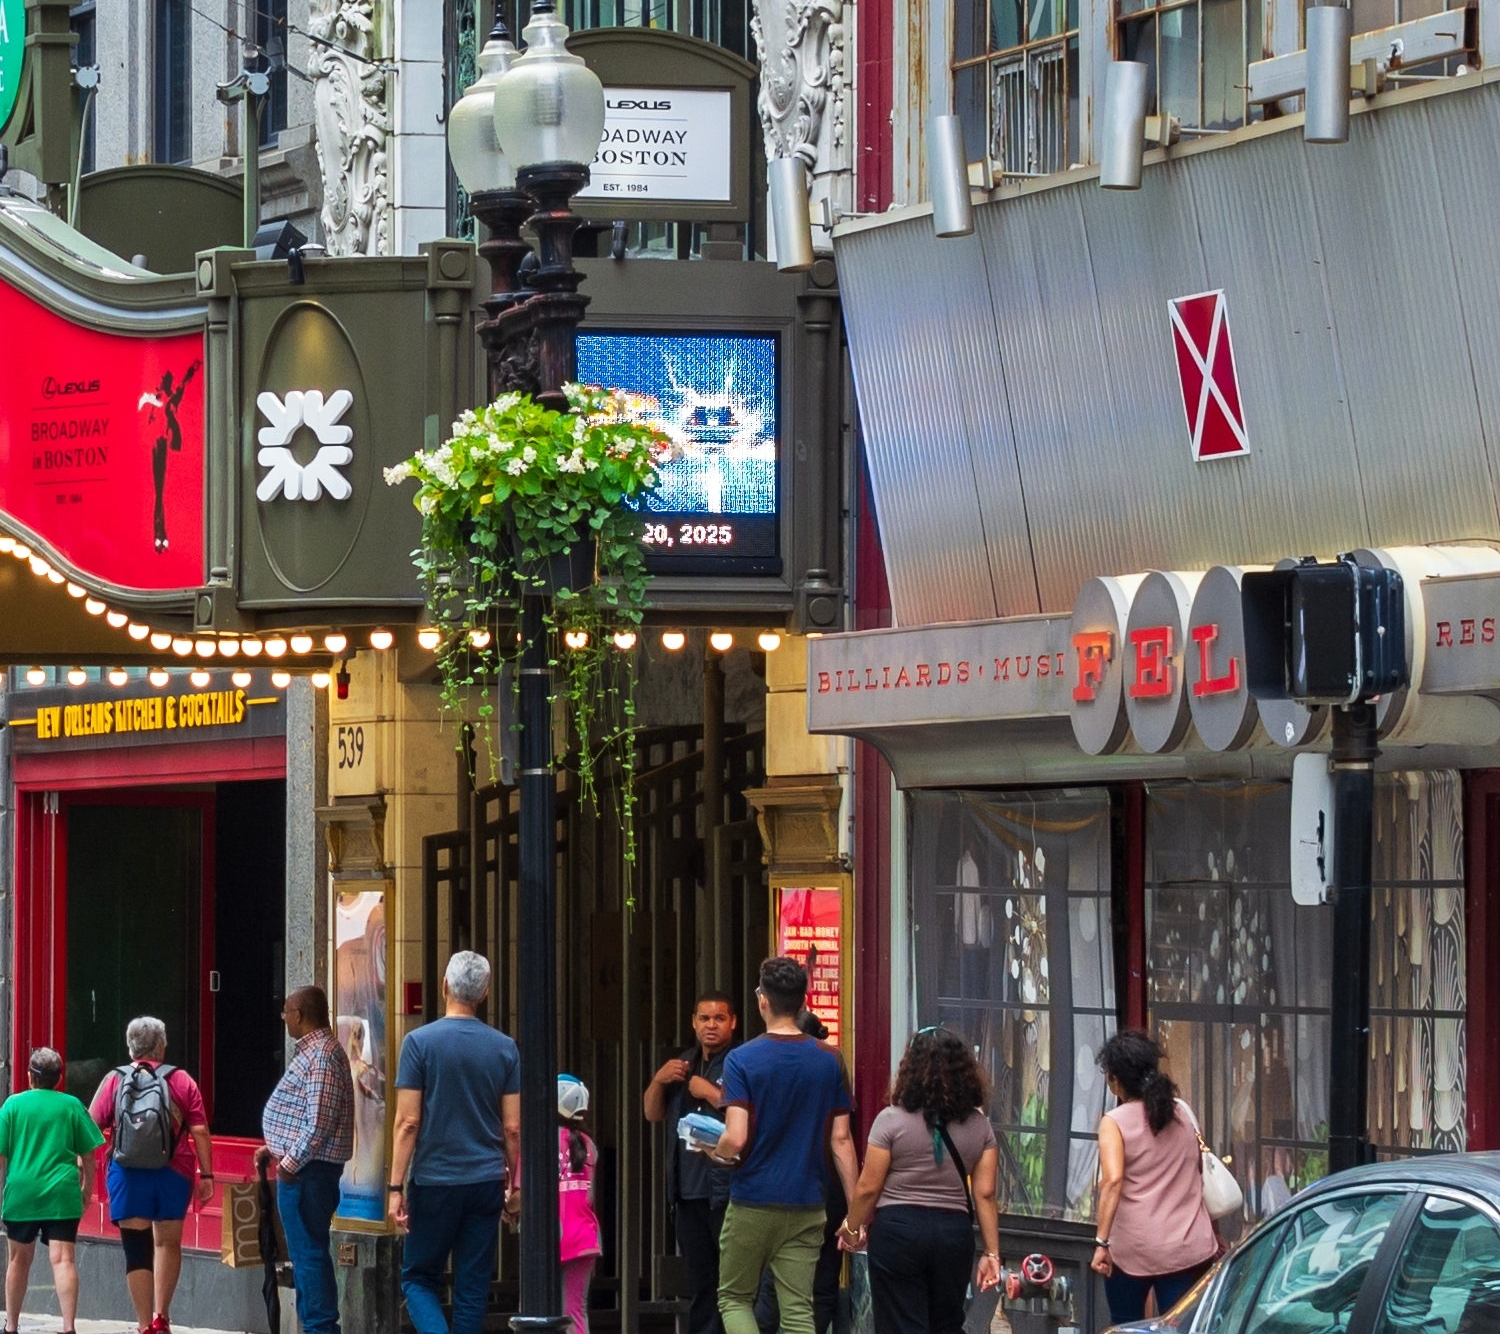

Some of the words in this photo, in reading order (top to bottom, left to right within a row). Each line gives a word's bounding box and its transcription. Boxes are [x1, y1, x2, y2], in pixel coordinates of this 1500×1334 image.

[607, 100, 671, 110] LEXUS
[600, 128, 688, 144] OADWAY
[603, 184, 623, 192] EST.
[57, 380, 100, 395] LEXUS
[31, 419, 109, 441] BROADWAY
[44, 447, 109, 469] BOSTON
[679, 524, 732, 544] 2025
[818, 661, 970, 693] BILLIARDS
[994, 653, 1065, 681] MUSI
[1072, 623, 1240, 702] FEL
[37, 707, 60, 738] NEW
[64, 701, 112, 737] ORLEANS
[115, 697, 163, 733] KITCHEN
[166, 695, 177, 728] &
[179, 689, 246, 727] COCKTAILS
[338, 726, 364, 769] 539
